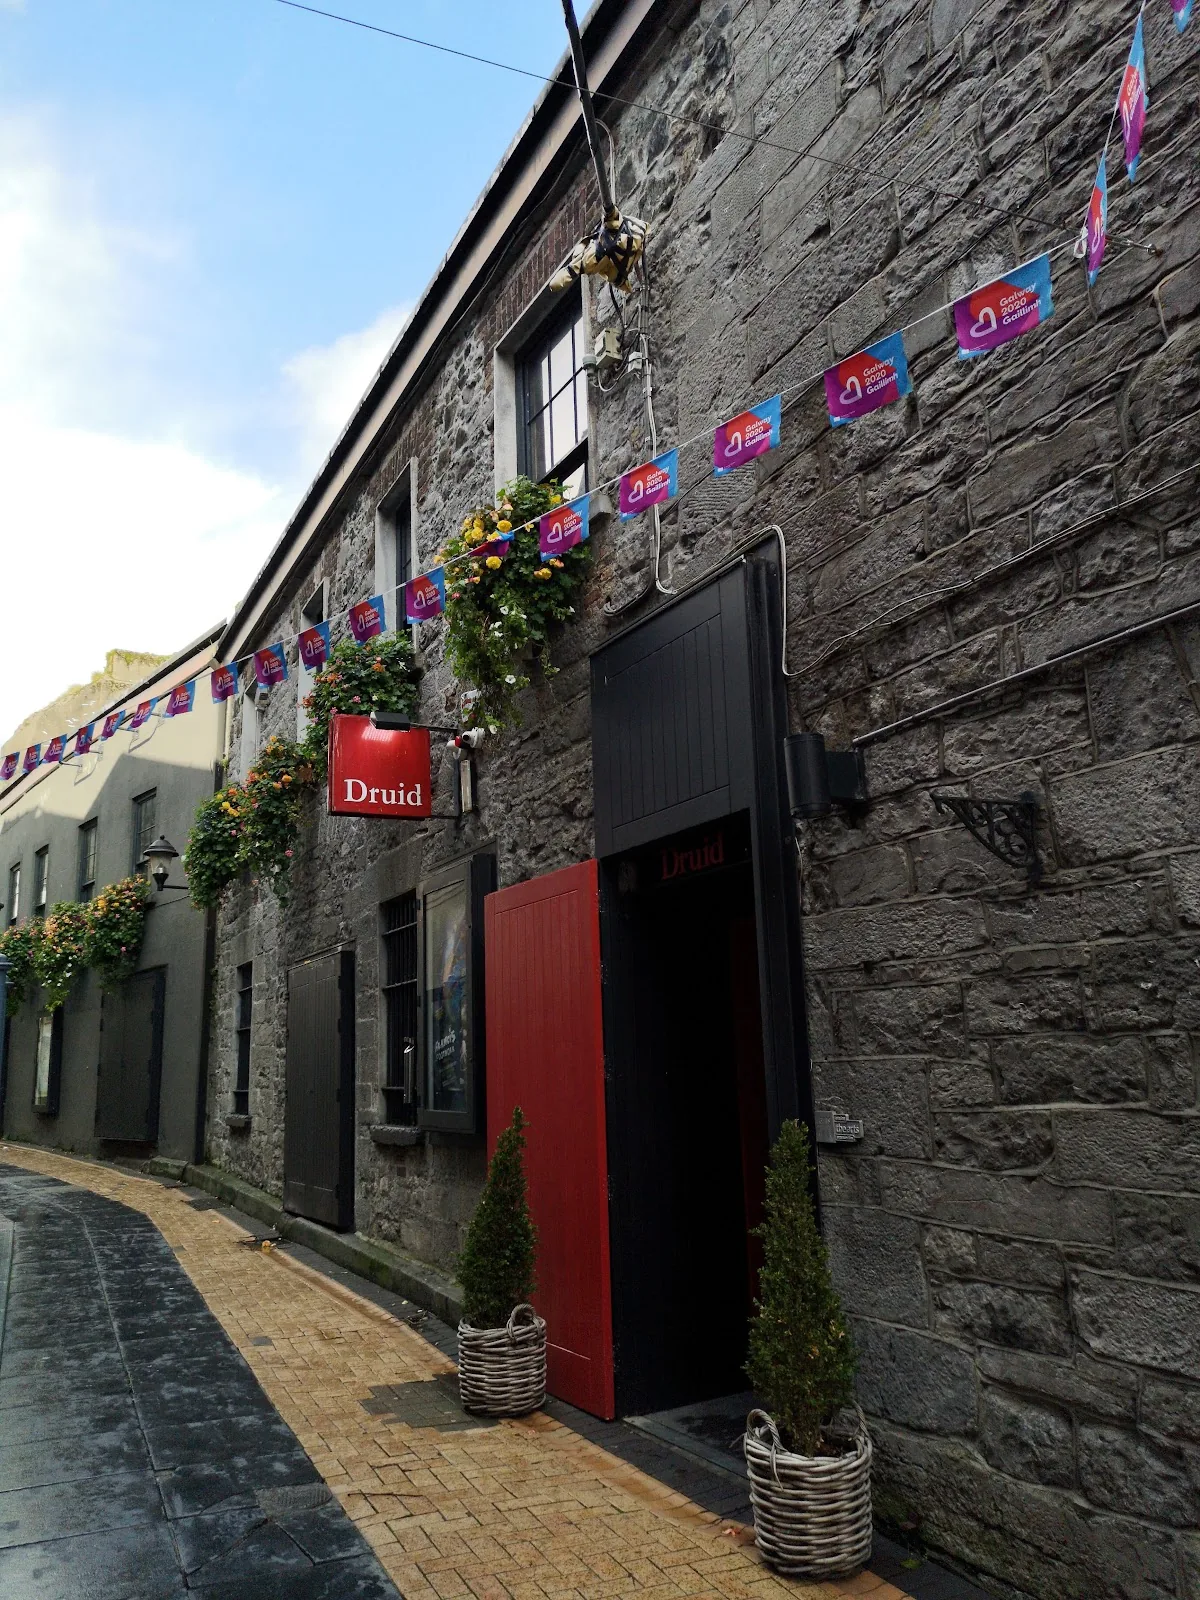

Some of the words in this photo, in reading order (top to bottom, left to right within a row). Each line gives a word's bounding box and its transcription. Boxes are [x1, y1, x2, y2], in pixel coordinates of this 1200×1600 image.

[1000, 283, 1036, 306] Galway
[1001, 297, 1027, 316] 2020
[1002, 300, 1041, 325] Gaillimh
[863, 356, 894, 377] Galway
[865, 369, 886, 386] 2020
[866, 372, 898, 394] Gaillimh
[745, 415, 772, 432] Galway
[745, 426, 764, 440] 2020
[343, 779, 423, 806] Druid
[660, 832, 724, 880] Druid
